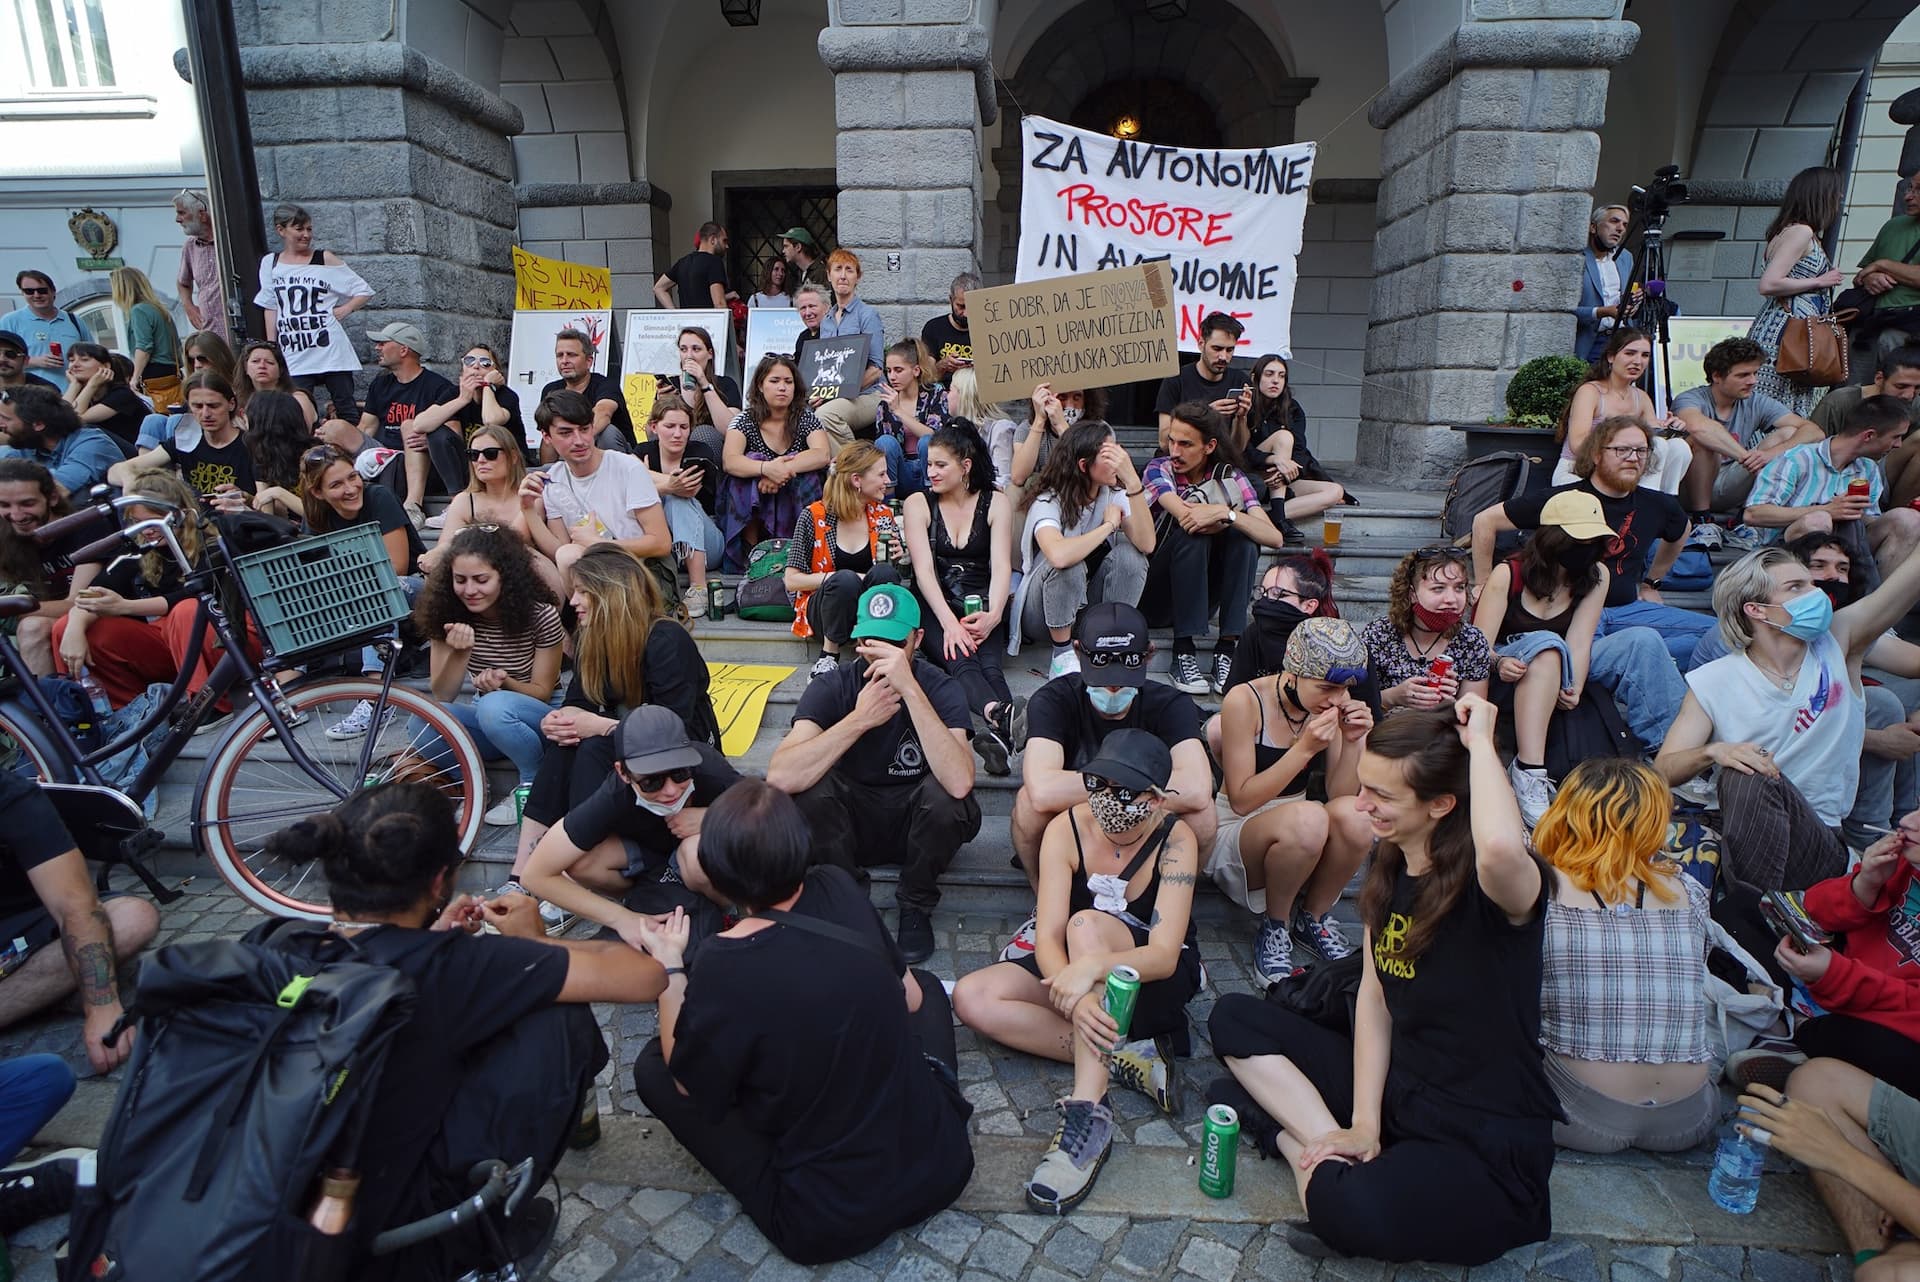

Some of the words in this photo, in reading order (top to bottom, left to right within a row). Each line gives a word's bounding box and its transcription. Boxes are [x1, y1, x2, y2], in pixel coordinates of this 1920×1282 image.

[1032, 132, 1088, 174] ZA
[1106, 139, 1310, 195] AVTONOMNE
[1057, 184, 1232, 247] PROSTORE
[1038, 233, 1077, 271] IN
[515, 253, 550, 284] RŠ
[557, 267, 609, 295] VLADA
[274, 285, 329, 317] TOE
[984, 299, 1001, 323] ŠE
[1010, 294, 1049, 320] DOBR,
[1053, 292, 1073, 313] DA
[1076, 287, 1096, 310] JE
[278, 316, 327, 332] PHOEBE
[280, 329, 330, 352] PHILO
[988, 326, 1046, 355] DOVOLJ
[992, 362, 1013, 383] ZA
[1021, 350, 1107, 379] PRORAČUNSKA
[1110, 338, 1169, 367] SREDSTVA
[809, 386, 840, 399] 2021
[1092, 653, 1107, 664] AC
[1125, 654, 1140, 665] AB
[1203, 1132, 1219, 1180] LAŠKO
